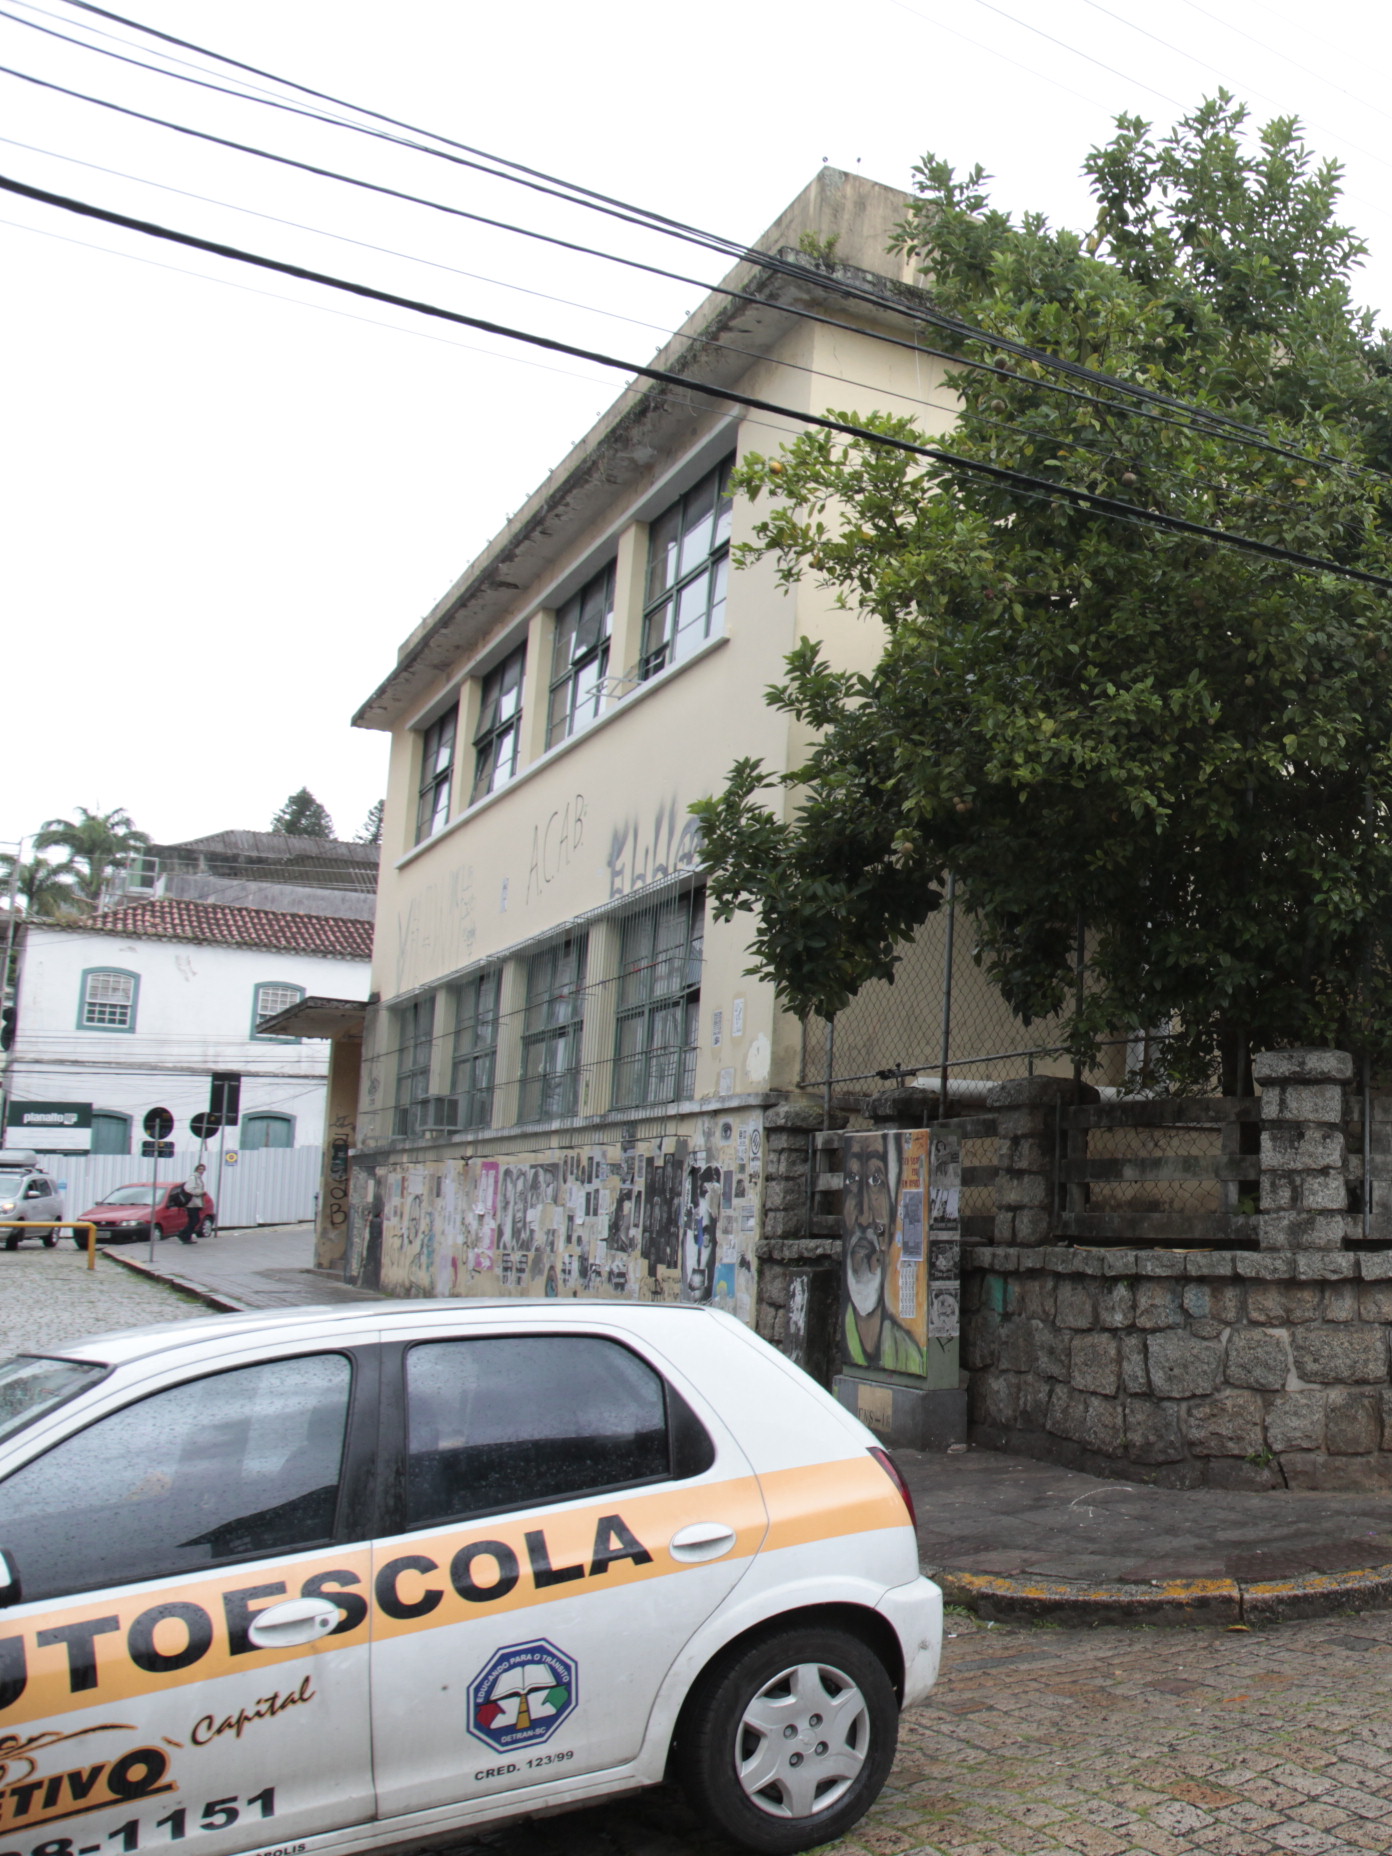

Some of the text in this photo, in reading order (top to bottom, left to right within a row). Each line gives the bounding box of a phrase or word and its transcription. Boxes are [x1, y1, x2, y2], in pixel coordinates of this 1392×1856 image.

[476, 1653, 570, 1703] EDUCANDO PARA O TRÂNSITO
[191, 1675, 315, 1746] Capital
[501, 1726, 546, 1743] DETRAN-SC
[0, 1748, 180, 1822] TIVO
[474, 1750, 574, 1781] CRED. 123/99
